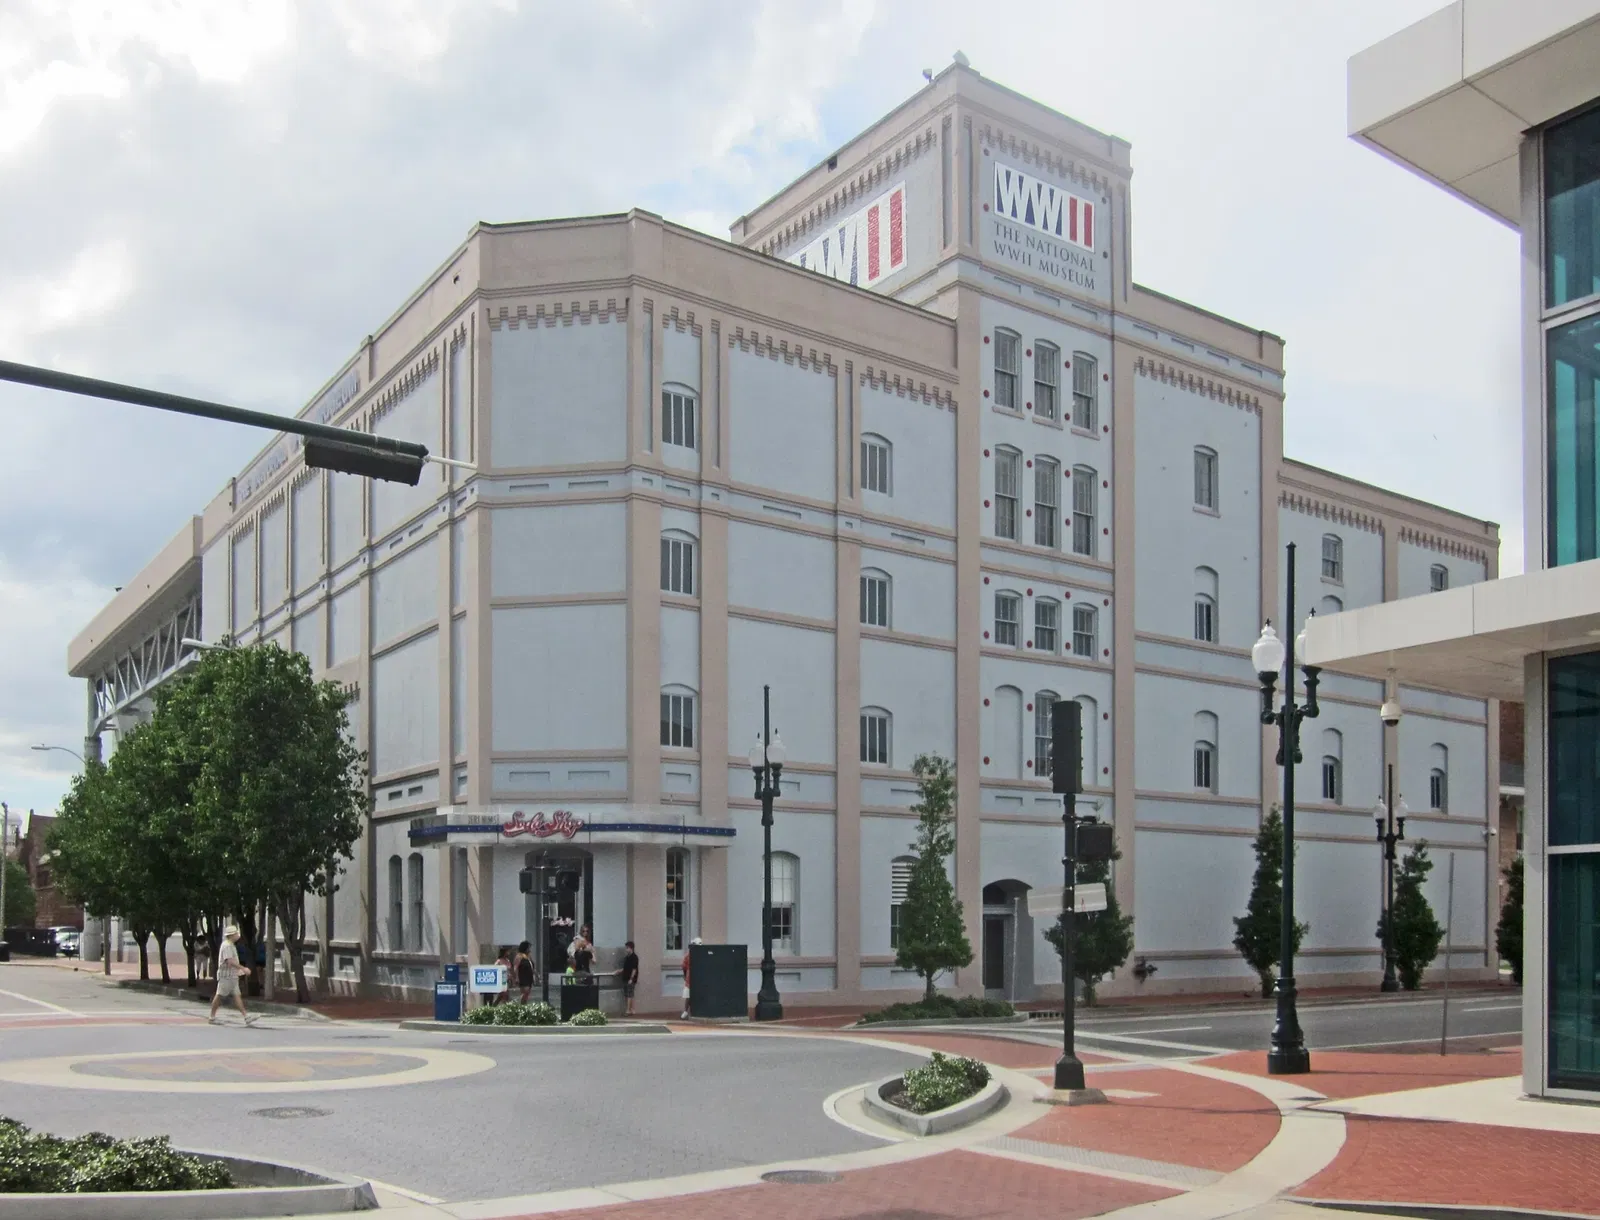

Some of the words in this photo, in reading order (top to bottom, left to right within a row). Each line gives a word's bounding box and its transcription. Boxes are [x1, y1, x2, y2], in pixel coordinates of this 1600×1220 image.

[995, 163, 1093, 250] WWII
[994, 220, 1021, 244] THE
[1026, 234, 1096, 272] NATIONAL
[994, 239, 1032, 266] WWII
[1038, 259, 1095, 290] MUSEUM
